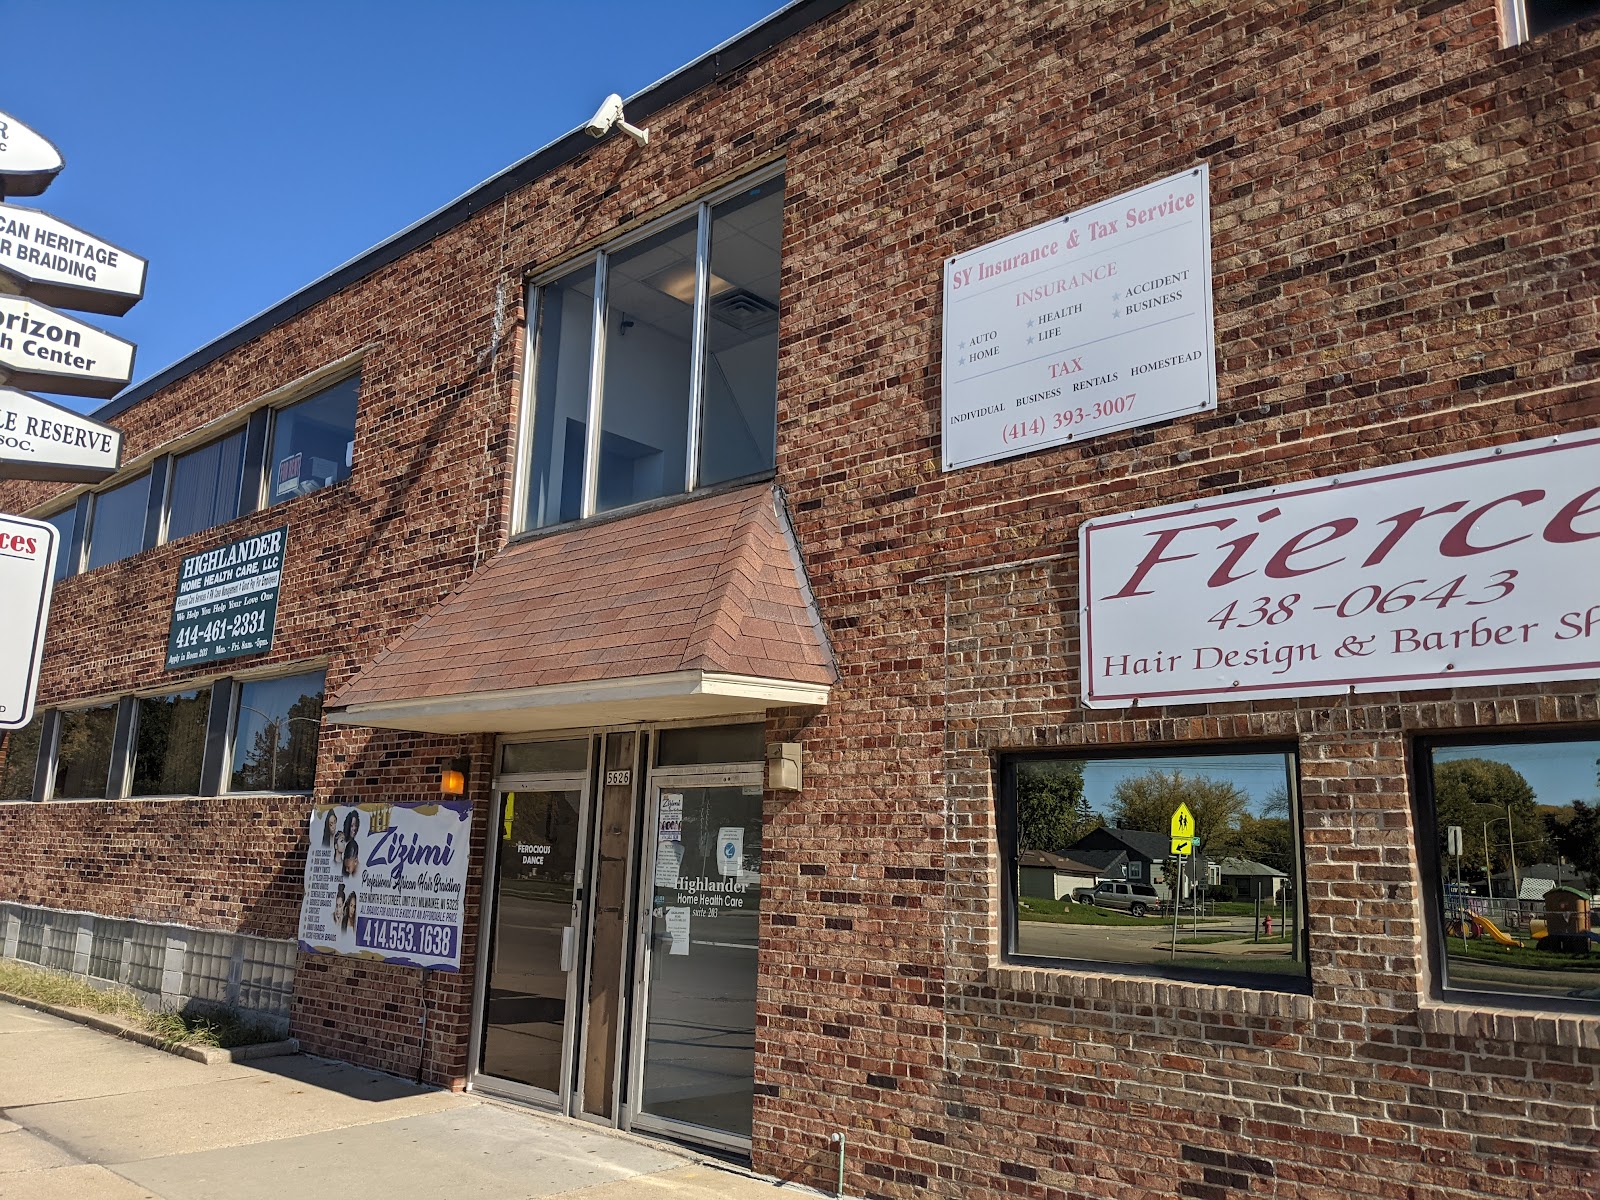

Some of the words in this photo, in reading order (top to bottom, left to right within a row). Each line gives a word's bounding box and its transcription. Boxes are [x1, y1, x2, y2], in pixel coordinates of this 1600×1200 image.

[34, 228, 118, 268] HERITAGE
[953, 267, 973, 290] SY
[978, 240, 1058, 280] Insurance
[1066, 229, 1080, 250] &
[1088, 219, 1118, 242] Tax
[1126, 192, 1196, 228] Service
[16, 244, 97, 283] BRAIDING
[1015, 262, 1118, 308] INSURANCE
[1125, 269, 1190, 298] ACCIDENT
[1038, 302, 1083, 326] HEALTH
[1125, 290, 1183, 316] BUSINESS
[0, 310, 81, 349] rizon
[969, 330, 998, 348] AUTO
[1038, 326, 1062, 342] LIFE
[22, 340, 96, 372] Center
[969, 346, 1000, 364] HOME
[1048, 356, 1084, 379] TAX
[950, 402, 1006, 425] INDIVIDUAL
[1016, 388, 1062, 408] BUSINESS
[1072, 372, 1119, 392] RENTALS
[1130, 350, 1202, 377] HOMESTEAD
[25, 416, 112, 454] RESERVE
[1002, 416, 1046, 444] (414)
[1053, 393, 1137, 430] 393-3007
[182, 531, 282, 579] HIGHLANDER
[1100, 486, 1600, 601] Fierce
[180, 578, 202, 593] HOME
[204, 568, 233, 586] HEALTH
[236, 562, 260, 578] CARE,
[262, 556, 280, 570] LLC
[186, 610, 199, 620] Help
[213, 603, 226, 612] Help
[260, 592, 274, 602] One
[176, 610, 266, 648] 414-461-2331
[1103, 653, 1182, 678] Hair
[1193, 639, 1318, 675] Design
[1334, 634, 1376, 658] &
[1391, 617, 1539, 655] Barber
[608, 772, 629, 784] 5626
[366, 826, 455, 880] Zizimi
[518, 844, 551, 854] FEROCIOUS
[522, 856, 544, 865] DANCE
[418, 871, 433, 892] Hair
[434, 873, 461, 900] Braiding
[674, 876, 749, 894] Highlander
[677, 893, 698, 904] Home
[700, 894, 723, 906] Health
[725, 895, 743, 907] Care
[363, 920, 452, 955] 414.553.1638
